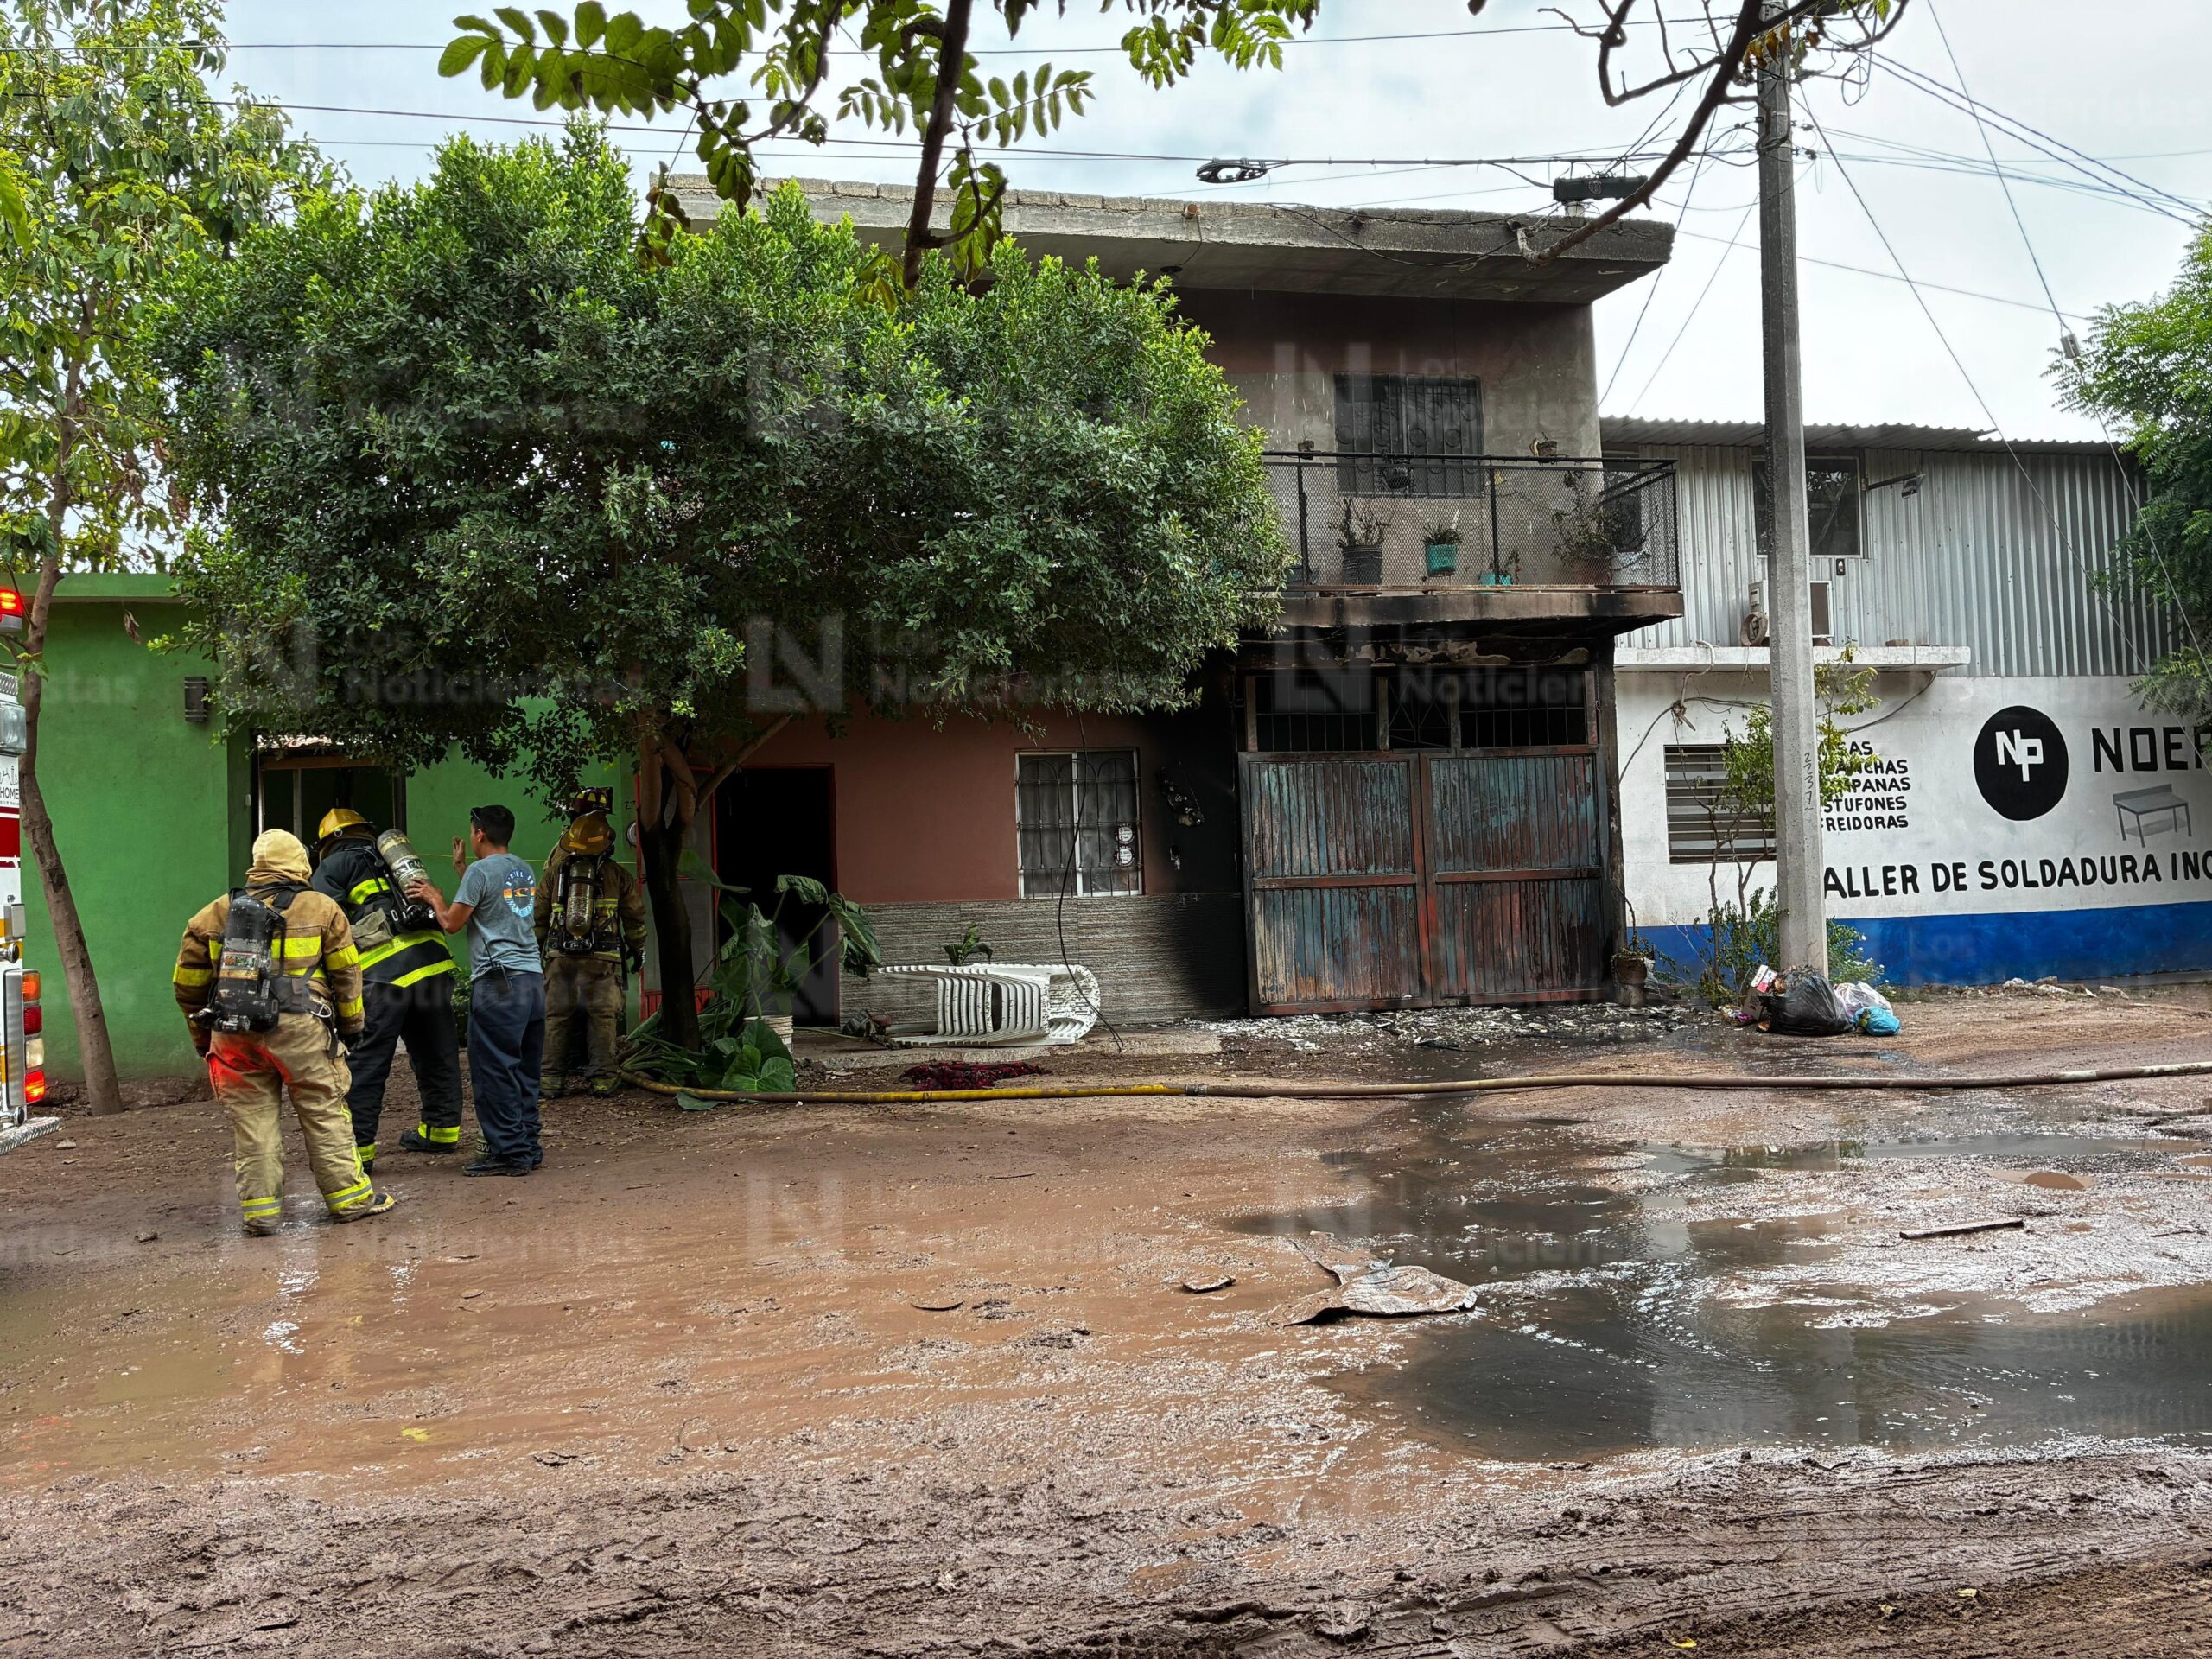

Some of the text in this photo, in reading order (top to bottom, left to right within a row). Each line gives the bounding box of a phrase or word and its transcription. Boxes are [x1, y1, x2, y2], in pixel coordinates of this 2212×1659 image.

[0, 787, 19, 799] HOME
[1847, 777, 1911, 793] PANAS
[1821, 796, 1907, 813] STUFONES
[1821, 815, 1909, 832] REIDORAS
[1824, 866, 1920, 899] ALLER
[1931, 862, 1968, 893] DE
[1977, 853, 2162, 891] SOLDADURA
